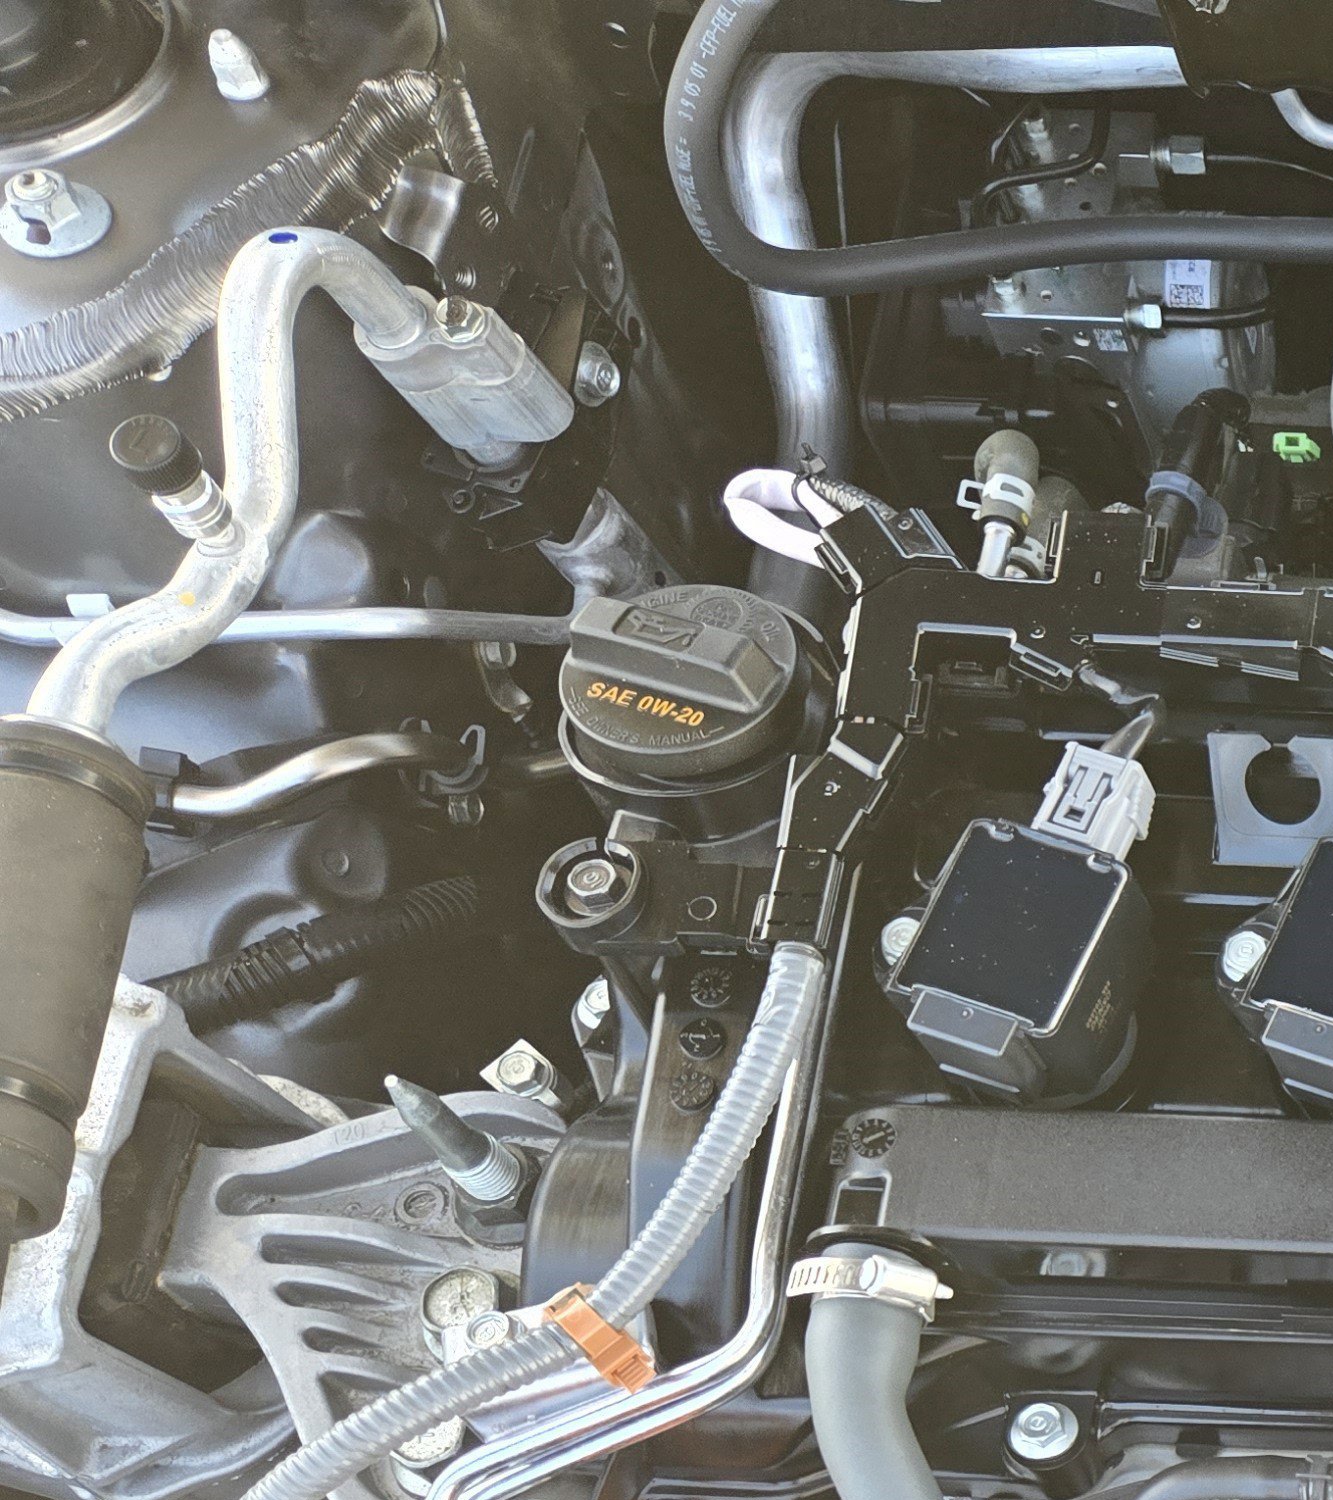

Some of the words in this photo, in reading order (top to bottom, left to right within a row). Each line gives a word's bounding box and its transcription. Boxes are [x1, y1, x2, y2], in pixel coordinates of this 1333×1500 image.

[586, 682, 637, 707] SAE
[636, 695, 706, 728] 0W-20
[586, 716, 640, 745] OWNER'S
[648, 730, 711, 748] MANUAL
